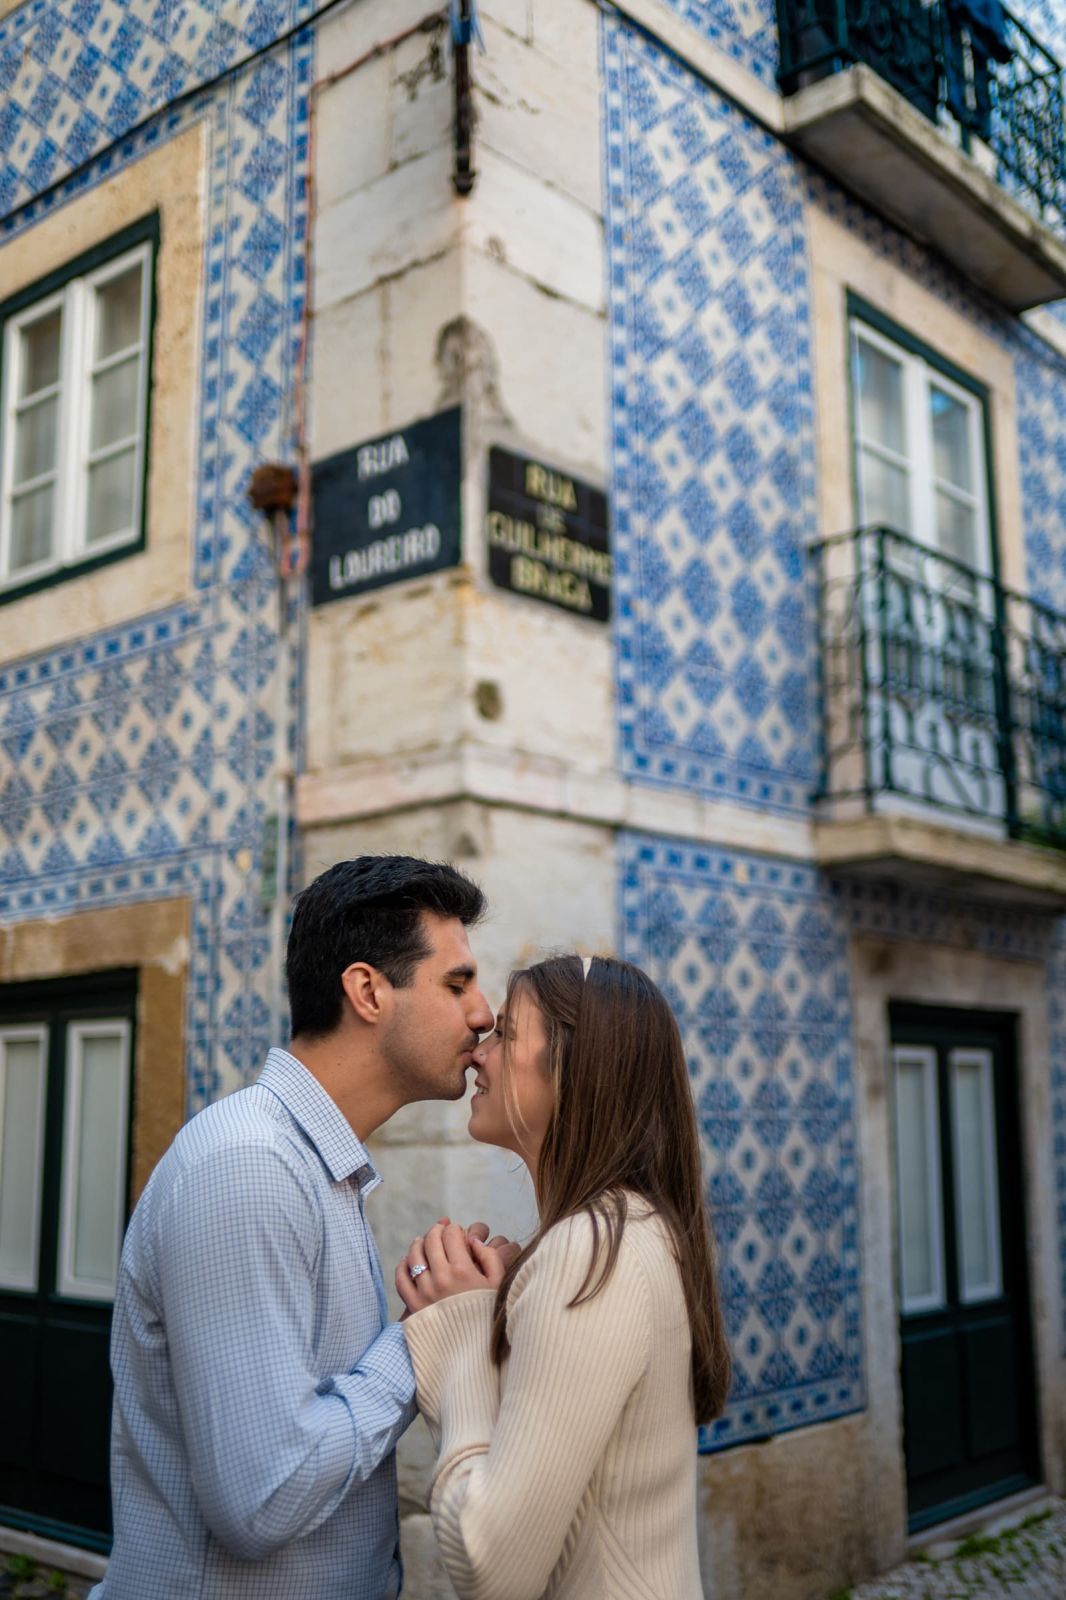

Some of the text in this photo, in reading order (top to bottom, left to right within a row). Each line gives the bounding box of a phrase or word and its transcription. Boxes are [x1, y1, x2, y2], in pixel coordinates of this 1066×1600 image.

[357, 435, 409, 480] RUA
[368, 488, 400, 529] DO
[526, 462, 577, 512] RUA
[329, 523, 441, 589] LOUREIRO
[510, 554, 592, 610] BRAGA
